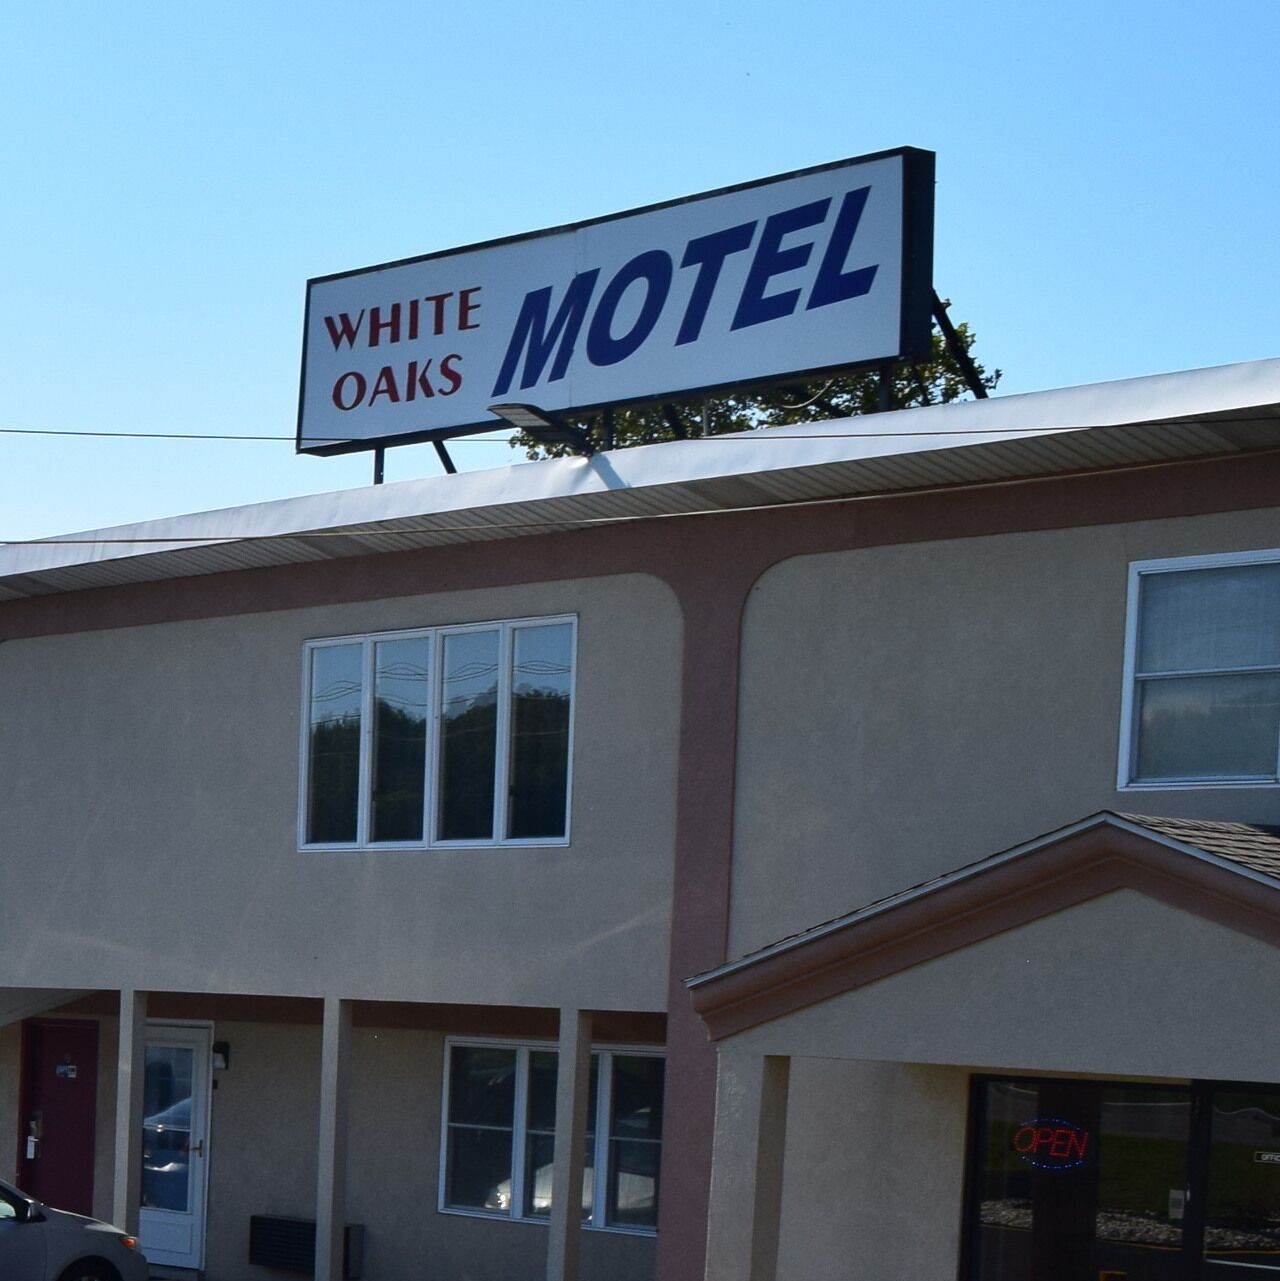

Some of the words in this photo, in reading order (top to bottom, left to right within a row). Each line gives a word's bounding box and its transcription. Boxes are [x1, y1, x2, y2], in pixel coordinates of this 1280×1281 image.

[324, 286, 482, 352] WHITE
[491, 185, 880, 398] MOTEL
[332, 353, 463, 411] OAKS
[1013, 1126, 1089, 1157] OPEN
